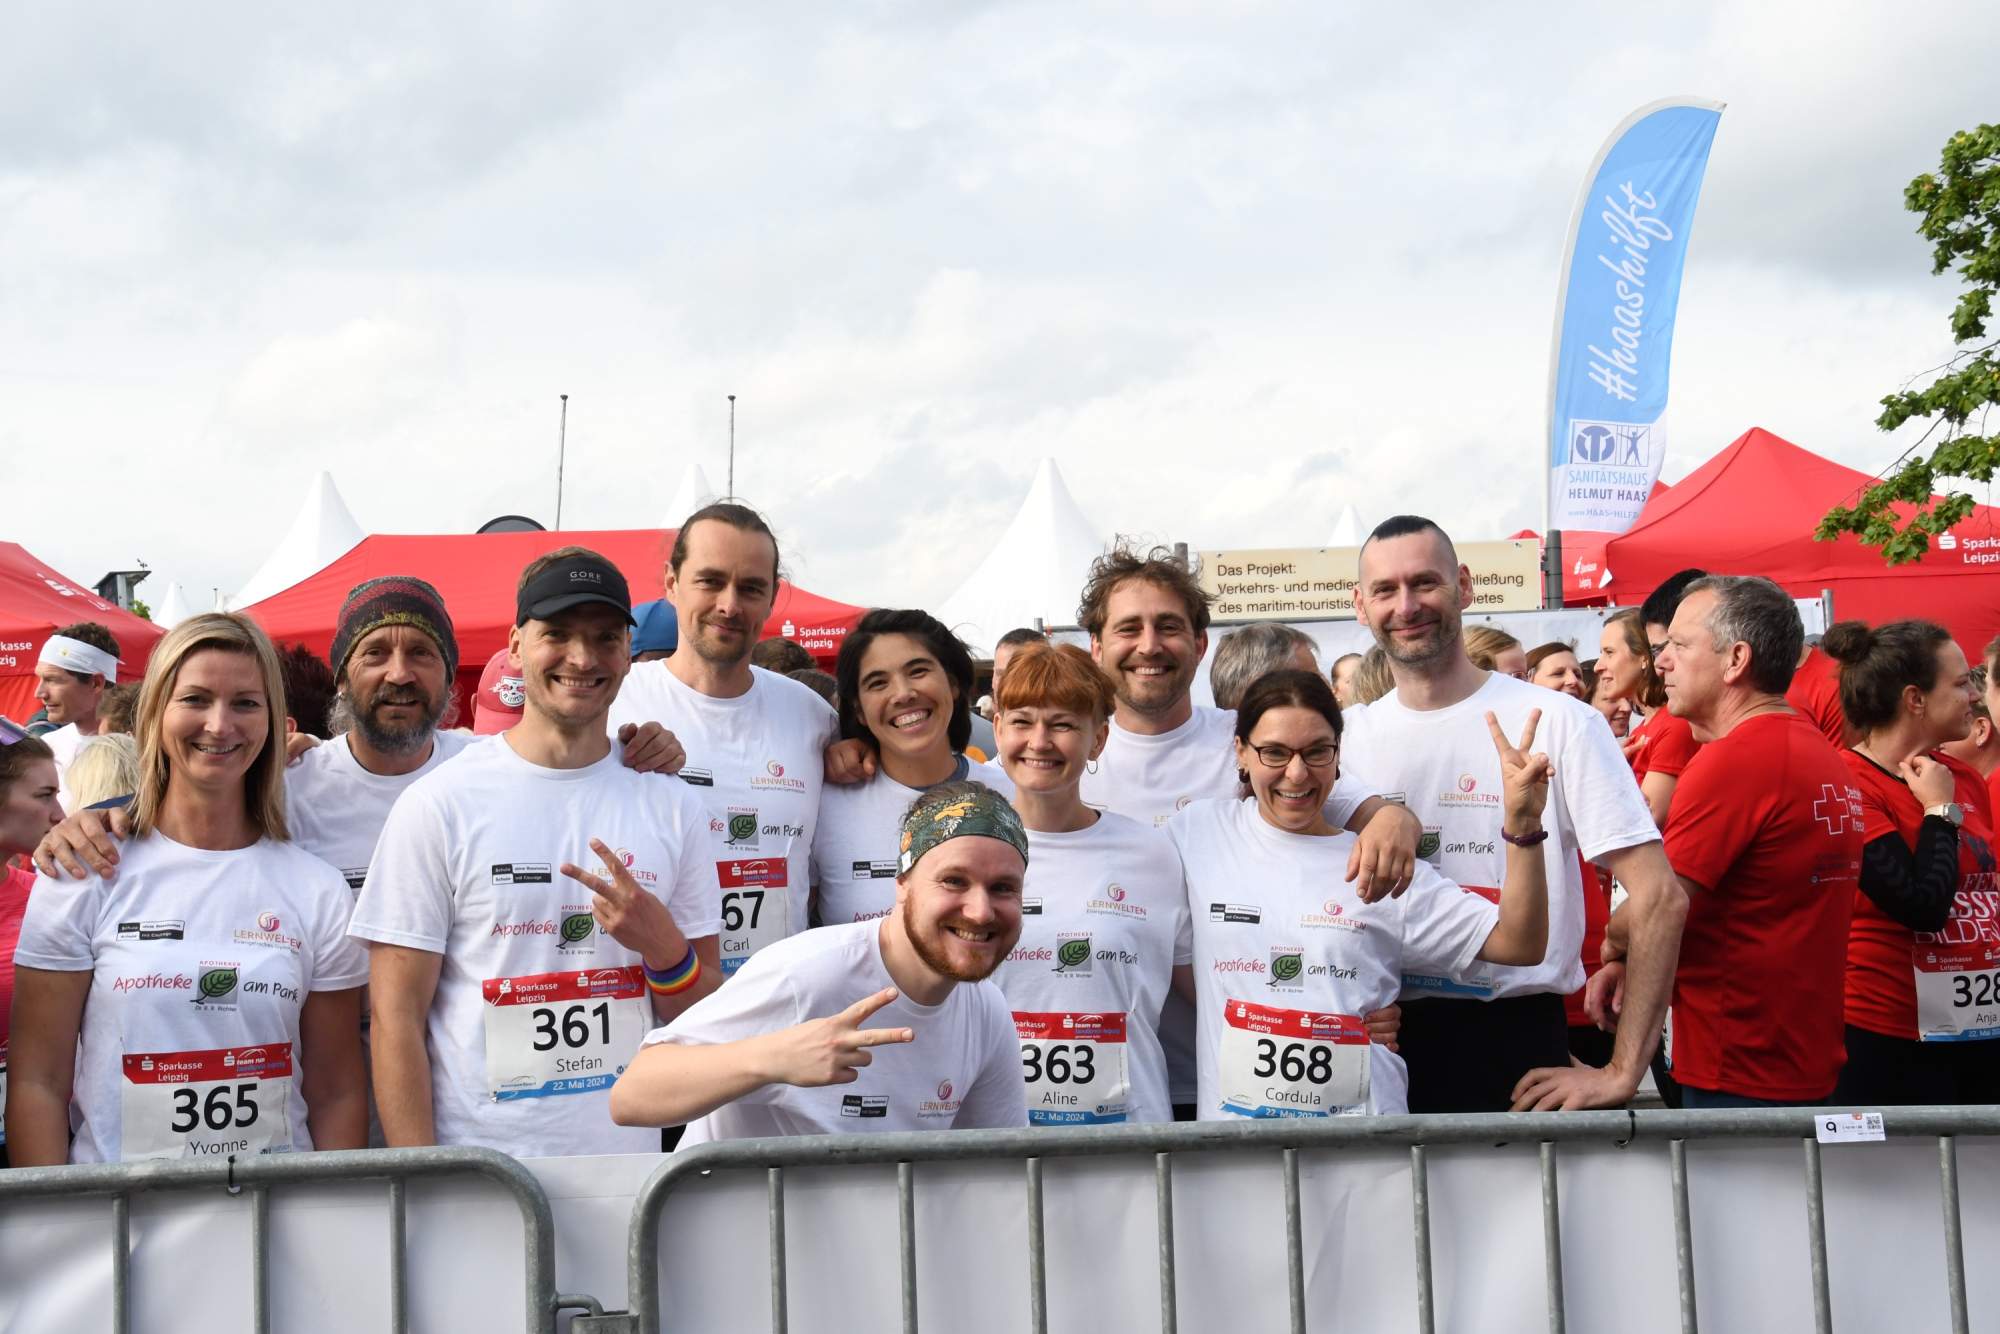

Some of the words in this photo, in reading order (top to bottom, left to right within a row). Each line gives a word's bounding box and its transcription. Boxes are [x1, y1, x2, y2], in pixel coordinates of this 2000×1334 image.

[1588, 180, 1673, 402] #haashilft
[1568, 488, 1613, 500] HELMUT
[1617, 489, 1648, 503] HAAS
[1217, 564, 1243, 577] Das
[1247, 563, 1296, 577] Projekt:
[1217, 582, 1280, 595] Verkehrs-
[1284, 580, 1309, 592] und
[1218, 602, 1243, 613] des
[799, 626, 847, 637] Sparkasse
[800, 638, 833, 649] Leipzig
[762, 824, 780, 836] am
[1445, 842, 1465, 854] am
[1468, 841, 1495, 855] Park
[491, 920, 558, 939] Apotheke
[723, 939, 750, 952] Carl
[1096, 950, 1117, 961] am
[1214, 957, 1266, 974] Apotheke
[1307, 965, 1326, 976] am
[1329, 965, 1358, 980] Park
[113, 973, 193, 994] Apotheke
[243, 980, 268, 994] am
[273, 981, 299, 1003] Park
[515, 983, 558, 993] Sparkasse
[516, 994, 546, 1005] Leipzig
[1248, 1012, 1283, 1025] Sparkasse
[1975, 1013, 1998, 1026] Anja
[532, 1001, 610, 1052] 361
[1247, 1022, 1272, 1034] Leipzig
[158, 1061, 203, 1072] Sparkasse
[556, 1056, 603, 1073] Stefan
[1021, 1043, 1096, 1085] 363
[1253, 1038, 1333, 1085] 368
[158, 1073, 189, 1083] Leipzig
[568, 1079, 585, 1089] Mai
[586, 1077, 606, 1087] 2024
[1042, 1091, 1079, 1105] Aline
[1265, 1087, 1321, 1105] Cordula
[171, 1083, 259, 1134] 365
[1048, 1111, 1064, 1121] Mai
[1065, 1112, 1085, 1121] 2024
[189, 1138, 249, 1156] Yvonne
